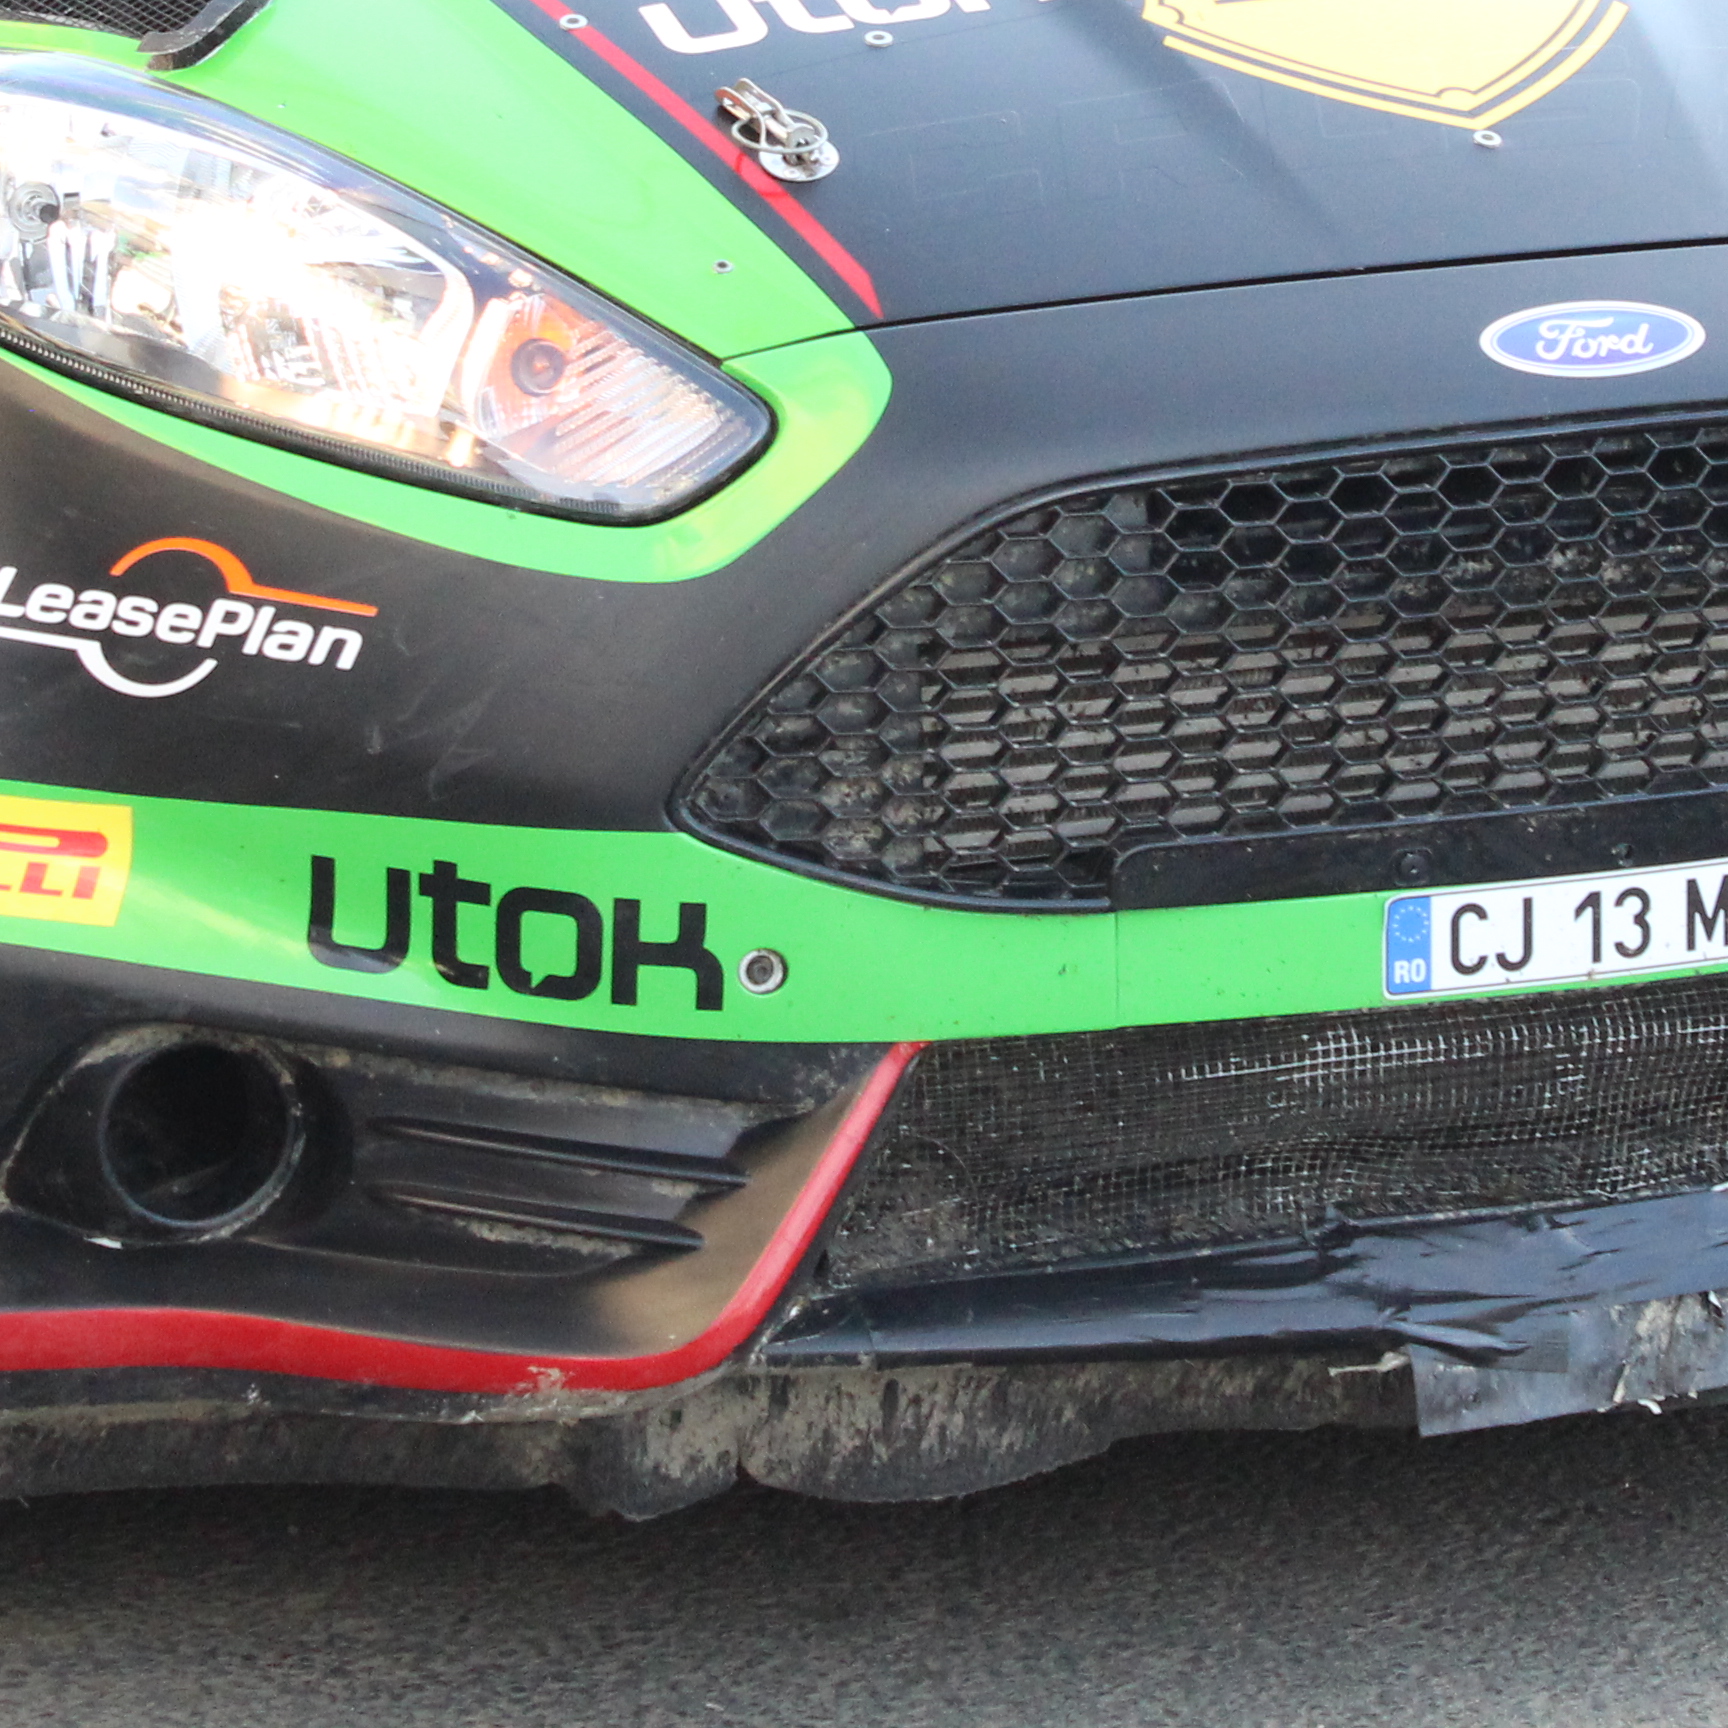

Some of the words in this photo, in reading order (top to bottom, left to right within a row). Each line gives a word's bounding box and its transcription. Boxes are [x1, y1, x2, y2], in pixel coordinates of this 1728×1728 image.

[1535, 318, 1655, 360] Ford
[1394, 958, 1427, 984] RO
[1450, 896, 1534, 976] CJ
[1574, 887, 1652, 964] 13
